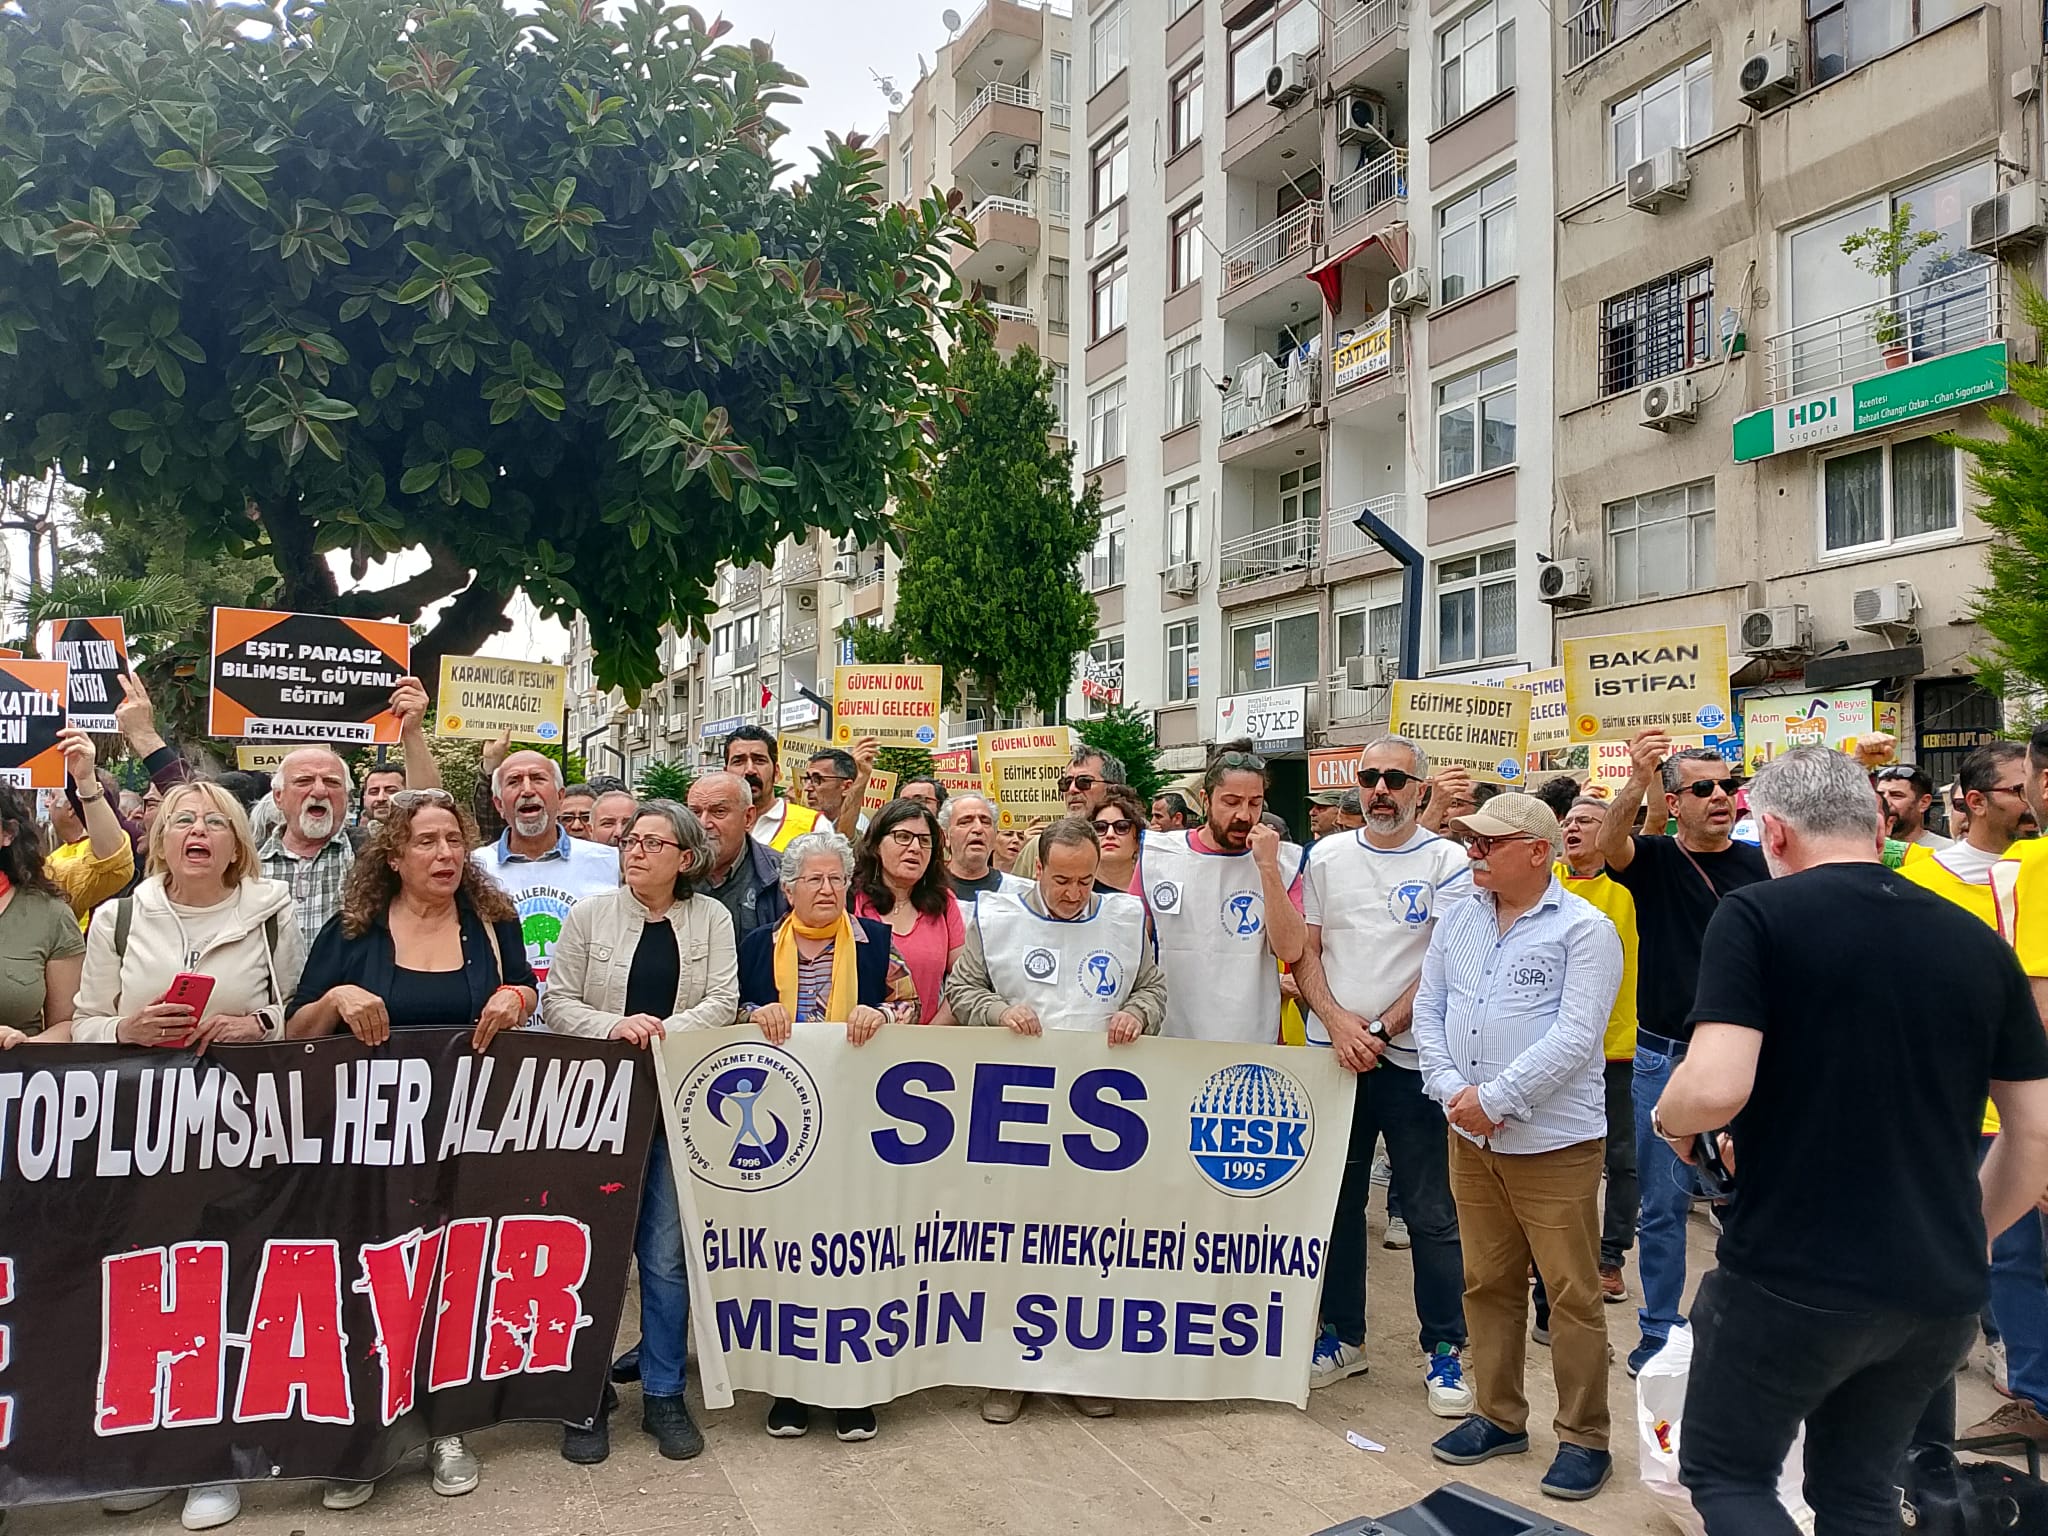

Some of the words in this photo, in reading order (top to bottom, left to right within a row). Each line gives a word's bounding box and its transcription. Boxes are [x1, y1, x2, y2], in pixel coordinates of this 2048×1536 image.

[1338, 332, 1387, 369] SATILIK
[1859, 393, 1888, 409] Acentesi
[1788, 396, 1837, 429] HDI
[1858, 411, 1880, 425] Behzat
[1789, 423, 1839, 444] Sigorta
[299, 645, 383, 665] PARASIZ
[1589, 643, 1699, 670] BAKAN
[450, 665, 515, 686] KARANLIĞA
[518, 670, 556, 690] TESLİM
[847, 672, 893, 691] GÜVENLİ
[895, 675, 925, 691] OKUL
[1594, 673, 1696, 697] İSTİFA!
[461, 691, 542, 713] OLMAYACAĞIZ!
[837, 697, 880, 716] GÜVENLİ
[882, 700, 936, 717] GELECEK!
[1410, 691, 1463, 713] EĞİTİME
[1466, 695, 1513, 719] ŞİDDET
[1834, 699, 1867, 711] Meyve
[465, 718, 485, 729] EĞİTİM
[486, 721, 497, 730] SEN
[1602, 714, 1626, 729] EĞİTİM
[1627, 714, 1641, 726] SEN
[1643, 712, 1670, 726] MERSİN
[1672, 712, 1692, 727] ŞUBE
[1695, 712, 1725, 724] KESK
[1751, 712, 1780, 724] Atom
[1838, 712, 1864, 723] Suyu
[991, 733, 1032, 752] GÜVENLİ
[1033, 734, 1057, 748] OKUL
[1399, 722, 1464, 743] GELECEĞE
[1466, 723, 1519, 748] İHANET!
[1533, 729, 1553, 742] EĞİTİM
[1553, 729, 1563, 739] SEN
[1785, 725, 1824, 746] fresh
[783, 739, 818, 755] KARANLIĞA
[786, 756, 808, 769] OLMAY
[1003, 764, 1037, 780] EĞİTİME
[1440, 756, 1453, 767] SEN
[1478, 760, 1495, 773] ŞUBE
[1496, 766, 1521, 775] KESK
[869, 777, 888, 791] KIR
[940, 778, 969, 790] SUSMA
[1000, 787, 1040, 803] GELECEĞE
[710, 1053, 754, 1073] HİZMET
[757, 1055, 812, 1106] EMEKÇİLERİ
[683, 1072, 710, 1114] SOSYAL
[0, 1066, 323, 1182] TOPLUMSAL
[331, 1057, 433, 1167] HER
[436, 1054, 635, 1163] ALANDA
[681, 1117, 690, 1133] VE
[870, 1060, 1149, 1173] SES
[786, 1108, 812, 1167] SENDİKASI
[1189, 1116, 1307, 1157] KESK
[683, 1135, 711, 1170] SAĞLIK
[736, 1157, 761, 1167] 1996
[740, 1172, 762, 1181] SES
[1221, 1161, 1267, 1181] 1995
[702, 1218, 768, 1273] ĞLIK
[773, 1240, 802, 1274] ve
[810, 1224, 906, 1278] SOSYAL
[914, 1210, 1014, 1265] HİZMET
[1022, 1217, 1186, 1279] EMEKÇİLERİ
[95, 1214, 594, 1437] HAYIR
[715, 1279, 987, 1365] MERSİN
[1012, 1290, 1284, 1362] ŞUBESİ
